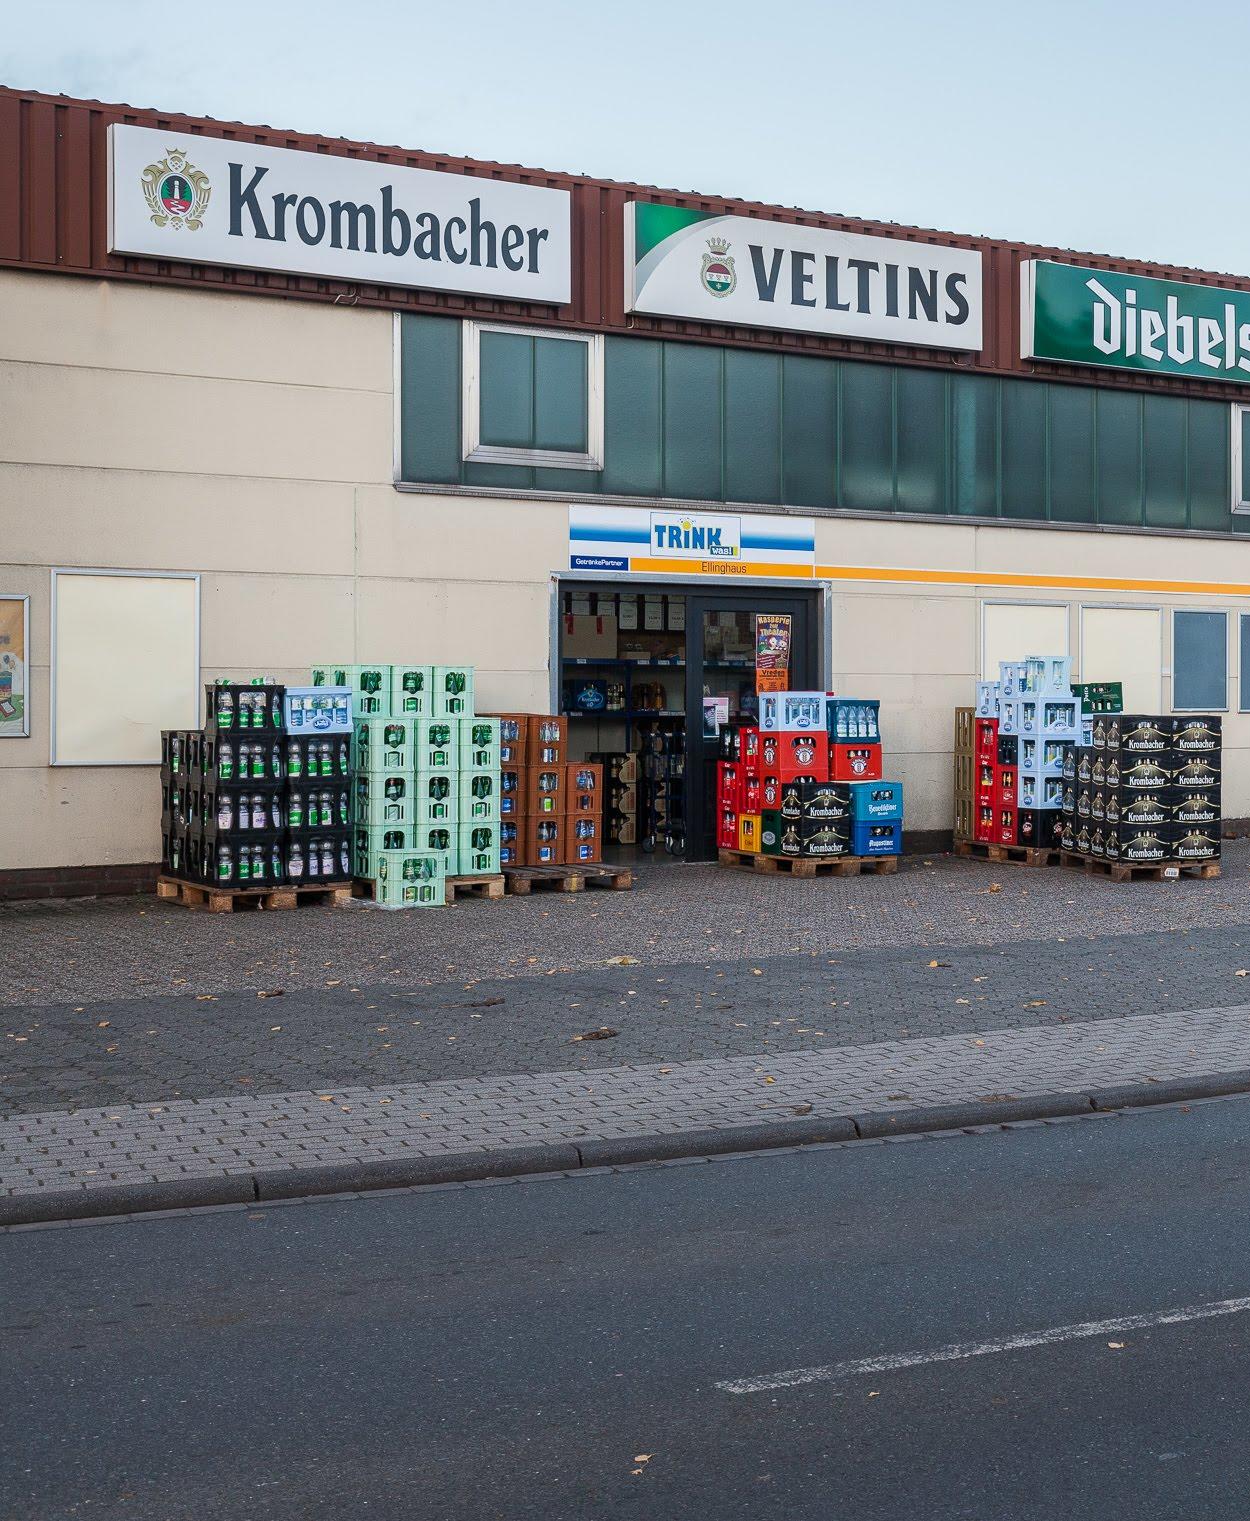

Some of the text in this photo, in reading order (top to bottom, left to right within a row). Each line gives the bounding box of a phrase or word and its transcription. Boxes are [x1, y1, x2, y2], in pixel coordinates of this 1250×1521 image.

[228, 162, 549, 274] Krombacher
[748, 244, 969, 326] VELTINS
[711, 546, 732, 556] was!
[701, 561, 747, 574] Ellinghaus
[1128, 739, 1165, 749] Krombacher
[1179, 739, 1215, 749] Krombacher
[1129, 776, 1165, 786] Krombacher
[1179, 775, 1215, 785] Krombacher
[810, 806, 843, 816] Krombacher
[1179, 811, 1215, 821] Krombacher
[1128, 812, 1164, 822] Krombacher
[809, 843, 843, 853] Krombacher
[1128, 848, 1164, 858] Krombacher
[1178, 846, 1214, 856] Krombacher
